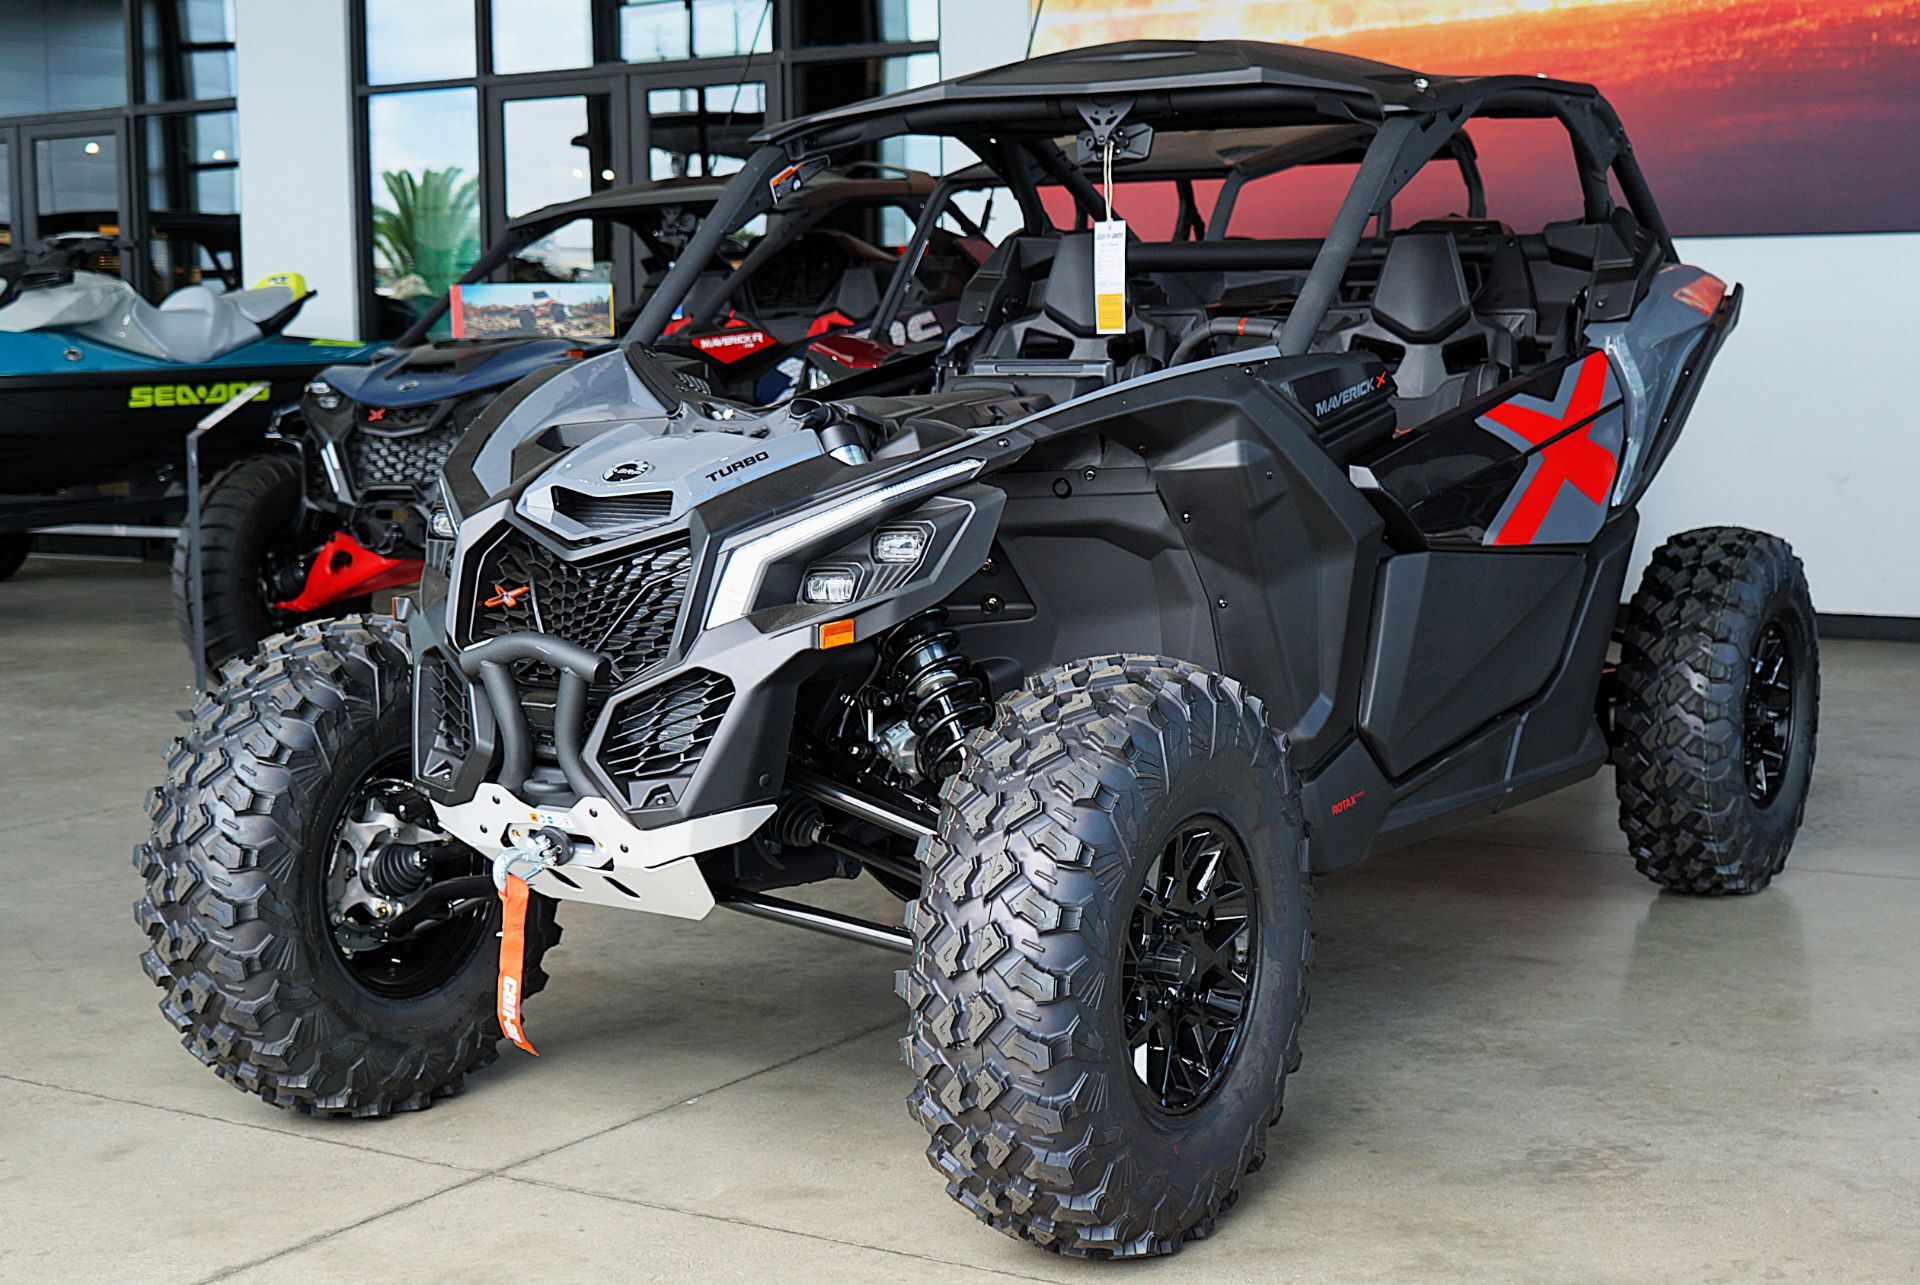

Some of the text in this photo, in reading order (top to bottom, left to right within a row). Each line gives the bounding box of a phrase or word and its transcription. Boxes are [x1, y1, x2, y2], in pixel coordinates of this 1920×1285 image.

[1314, 376, 1376, 417] MAVERICK
[705, 451, 769, 482] TURBO
[1331, 795, 1357, 816] ROTAX
